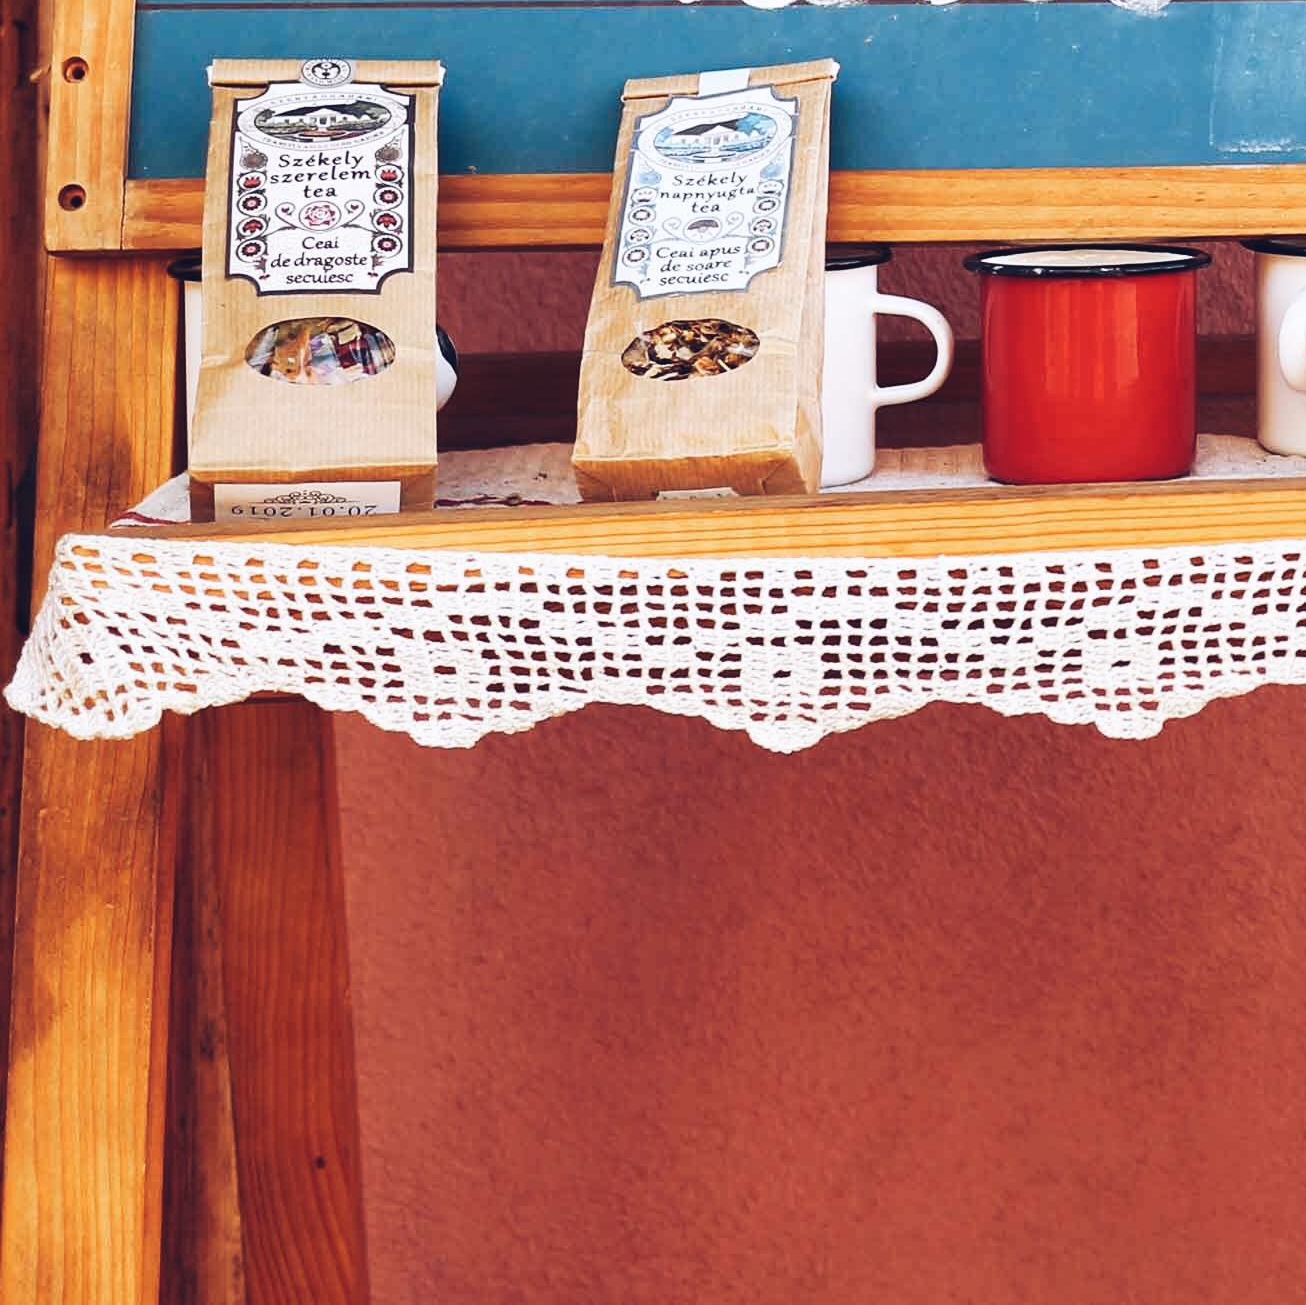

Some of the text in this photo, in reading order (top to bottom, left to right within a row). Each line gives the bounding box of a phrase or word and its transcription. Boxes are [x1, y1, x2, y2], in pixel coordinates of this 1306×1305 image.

[278, 151, 364, 168] Székely
[270, 166, 371, 184] szerelem
[672, 171, 747, 187] Székely
[303, 185, 337, 199] tea
[660, 185, 756, 202] napnyugta
[691, 200, 721, 214] tea
[302, 235, 340, 251] Ceai
[656, 244, 741, 262] Ceai apus
[270, 252, 368, 272] de dragoste
[660, 258, 733, 273] de soare
[286, 269, 354, 285] secuiesc
[659, 271, 729, 286] secuiesc
